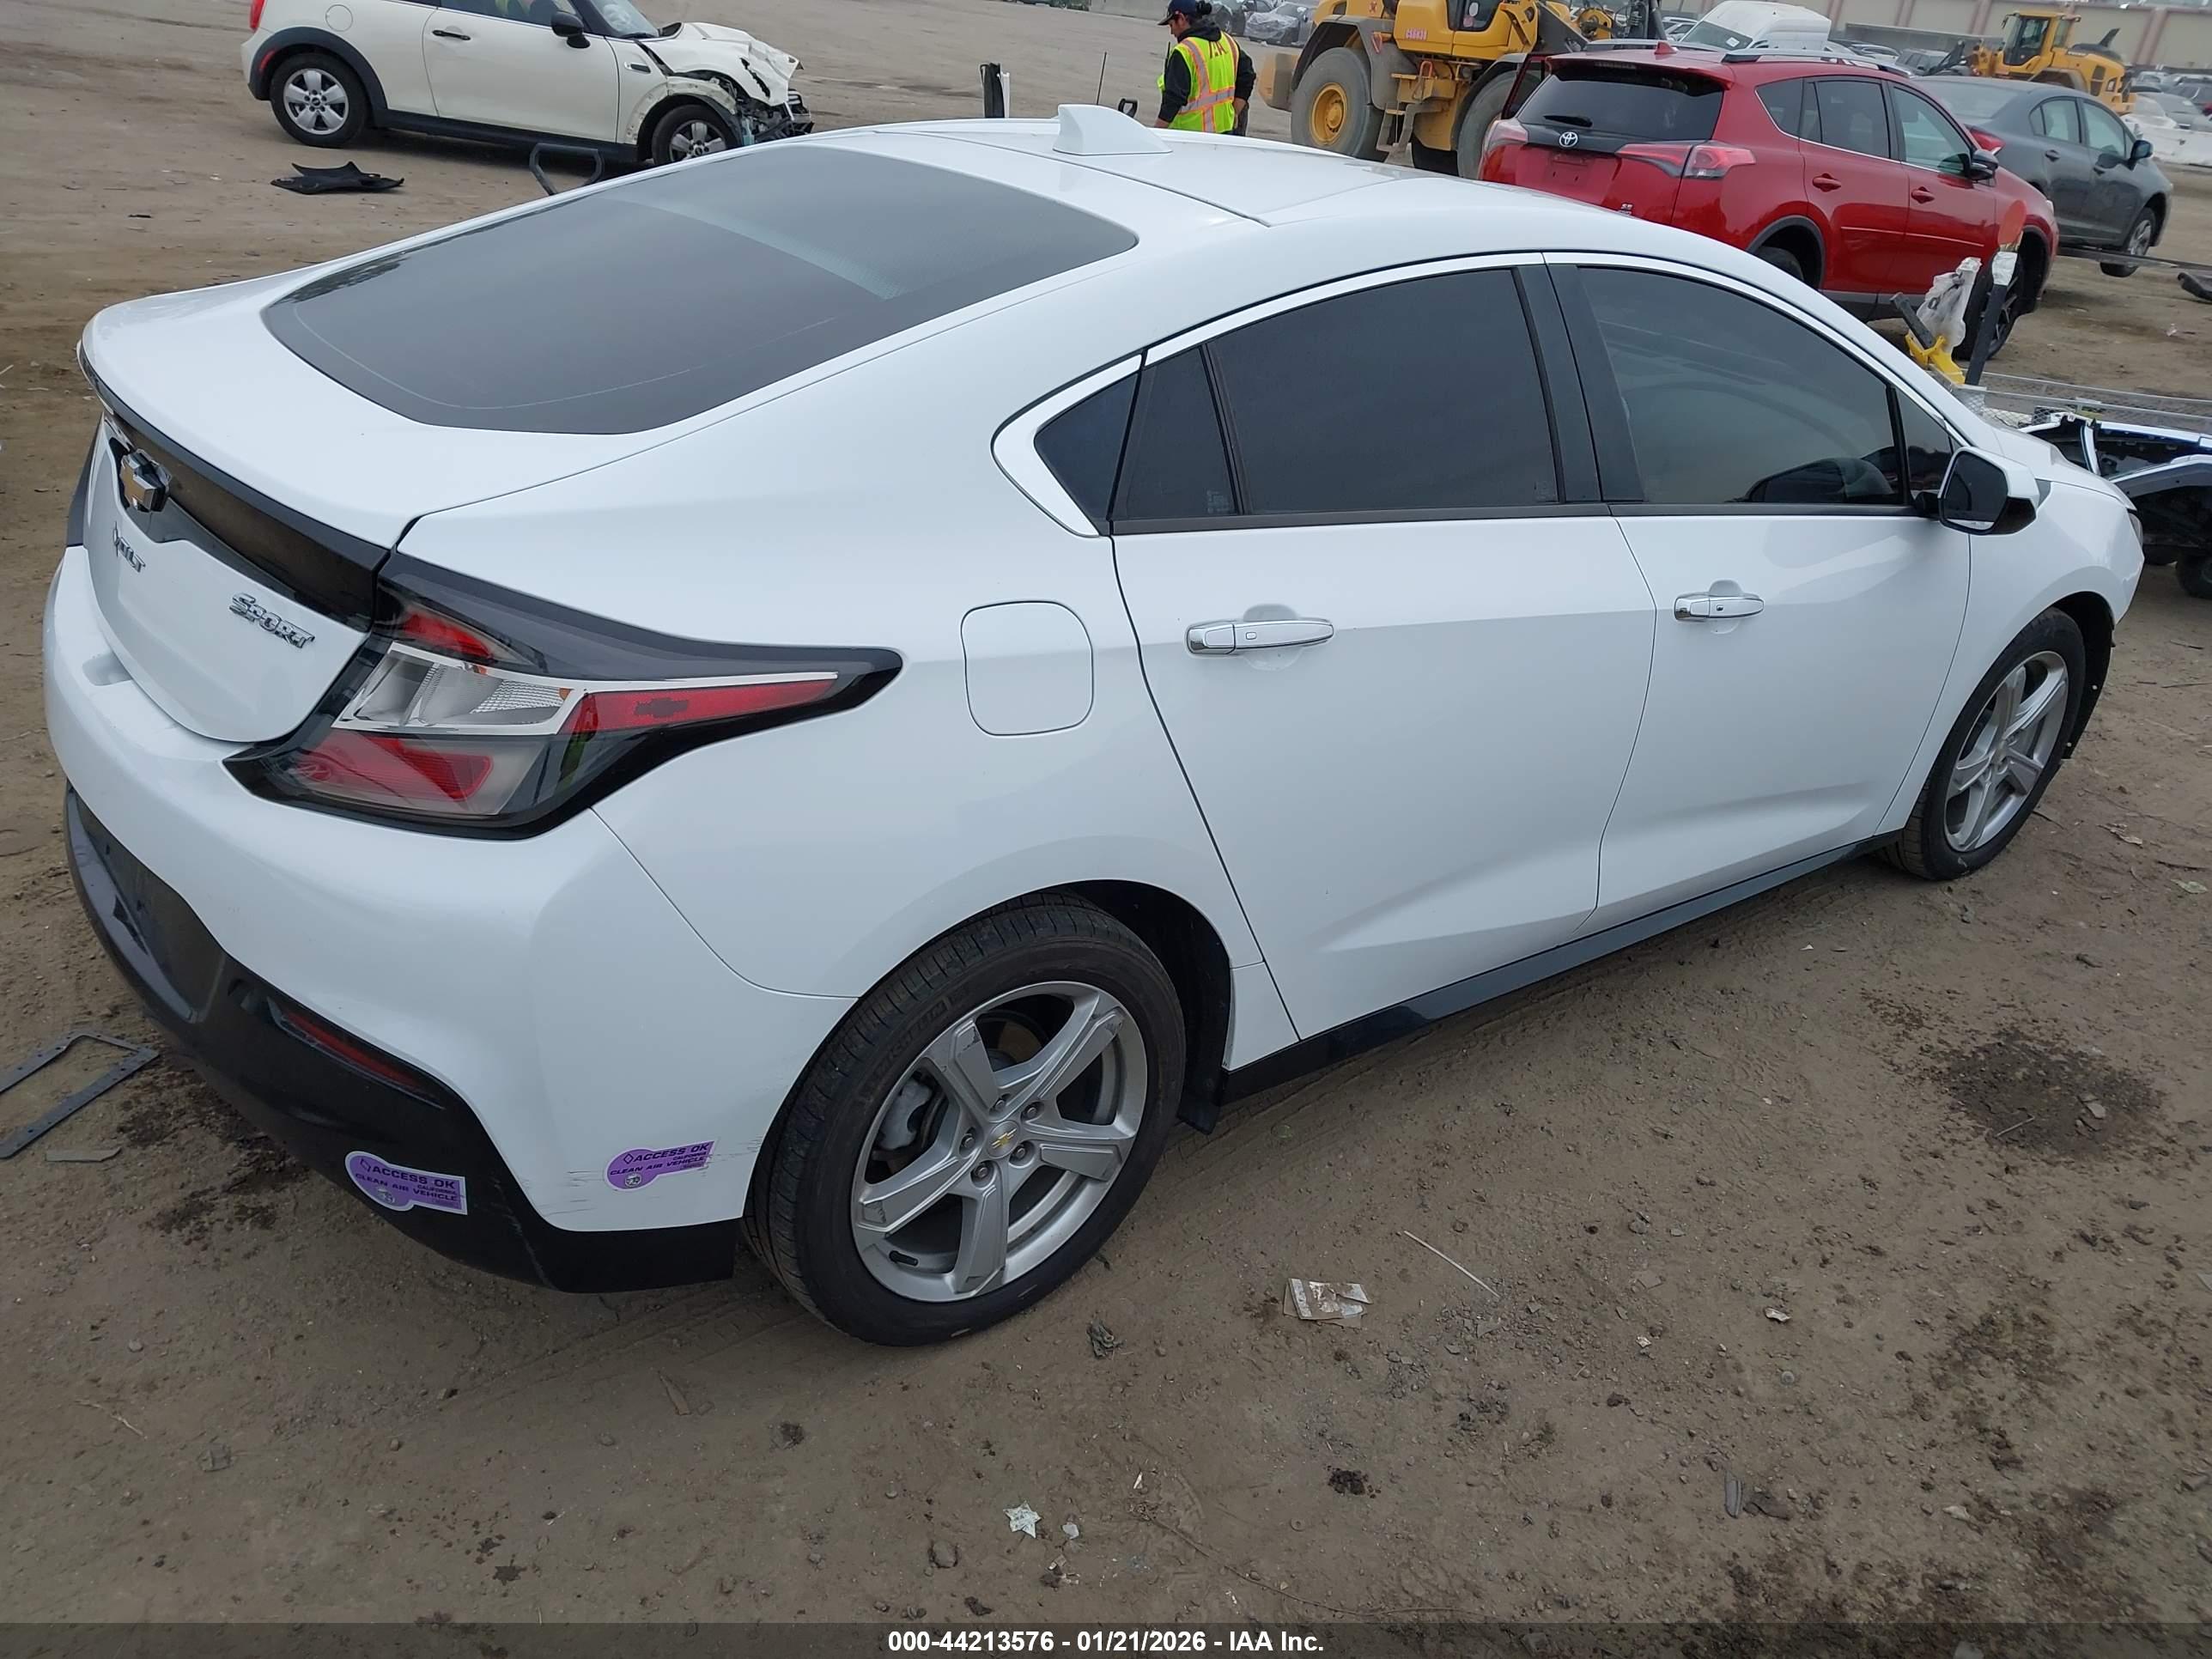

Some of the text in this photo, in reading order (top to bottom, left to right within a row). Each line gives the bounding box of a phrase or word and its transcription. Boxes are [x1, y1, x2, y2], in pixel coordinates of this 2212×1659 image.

[112, 521, 146, 573] VOLT
[229, 592, 315, 648] SPORT
[633, 1143, 709, 1162] ACCESS OK
[372, 1166, 456, 1189] ACCESS OK
[610, 1166, 642, 1175] CLEAN
[666, 1157, 704, 1166] VEHICLE
[356, 1173, 459, 1200] CLEAN AIR VEHICLE
